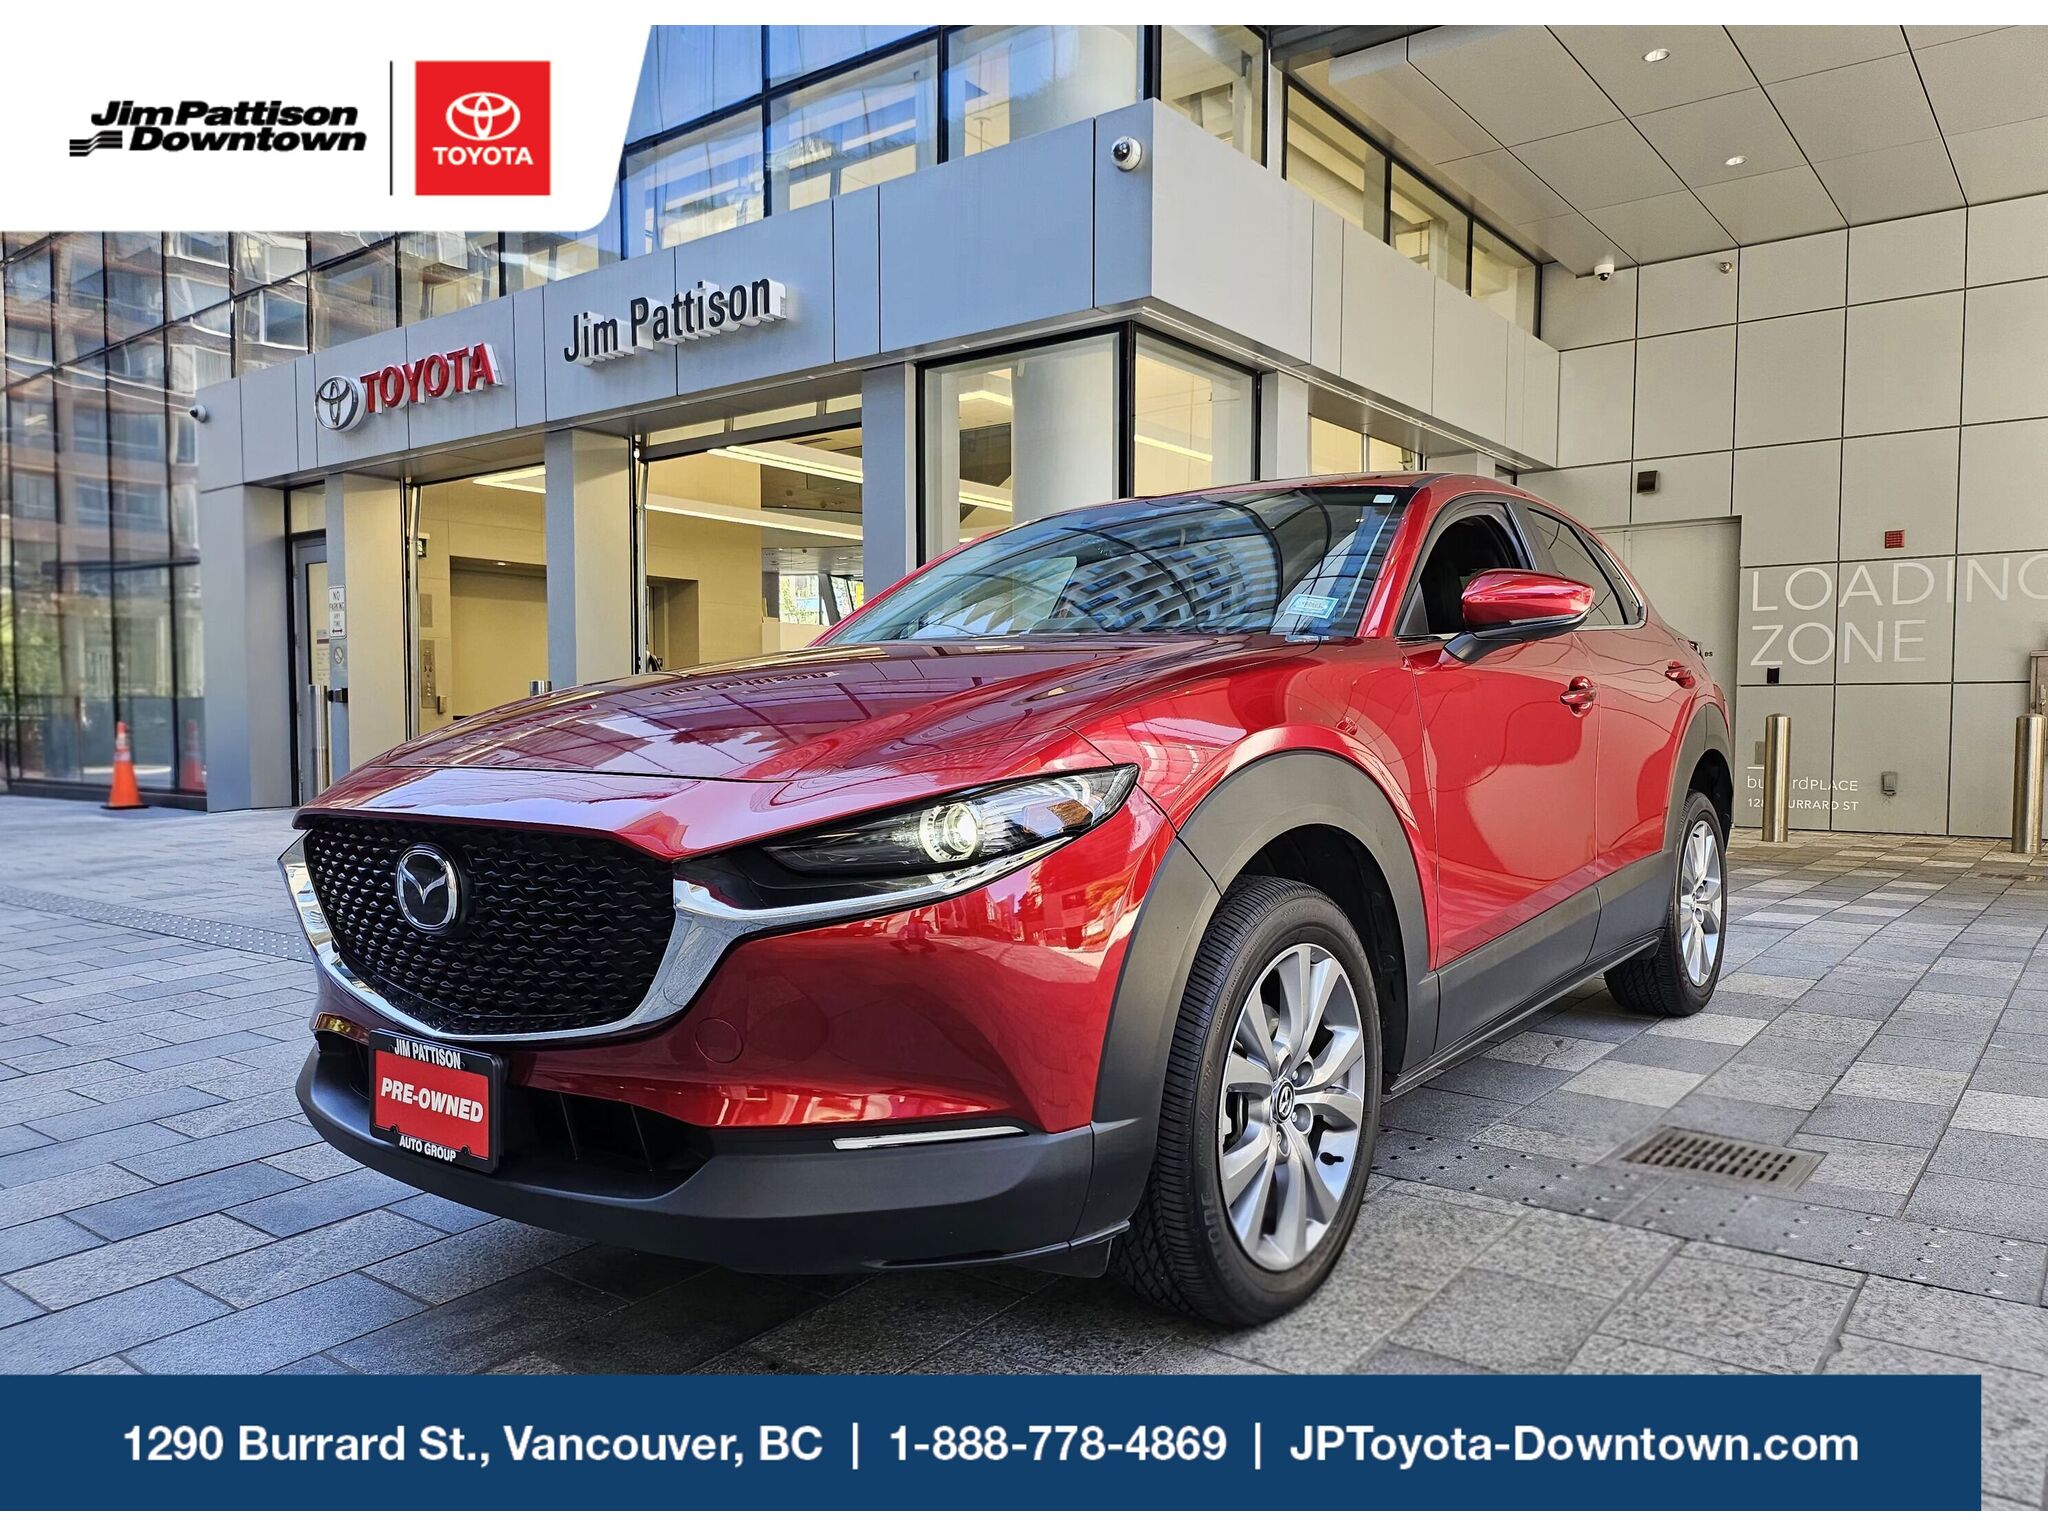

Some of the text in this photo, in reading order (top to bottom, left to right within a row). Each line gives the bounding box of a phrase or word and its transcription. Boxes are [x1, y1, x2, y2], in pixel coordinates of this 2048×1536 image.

[563, 278, 771, 363] Jim Pattison
[360, 343, 496, 414] TOYOTA
[1750, 619, 1927, 667] ZONE
[1747, 775, 1858, 792] burdPLACE
[1788, 799, 1839, 811] URRARD
[1842, 801, 1859, 811] ST
[394, 1038, 462, 1070] JIM PATTISON
[380, 1077, 484, 1123] PRE-OWNED
[399, 1135, 457, 1163] AUTO GROUP
